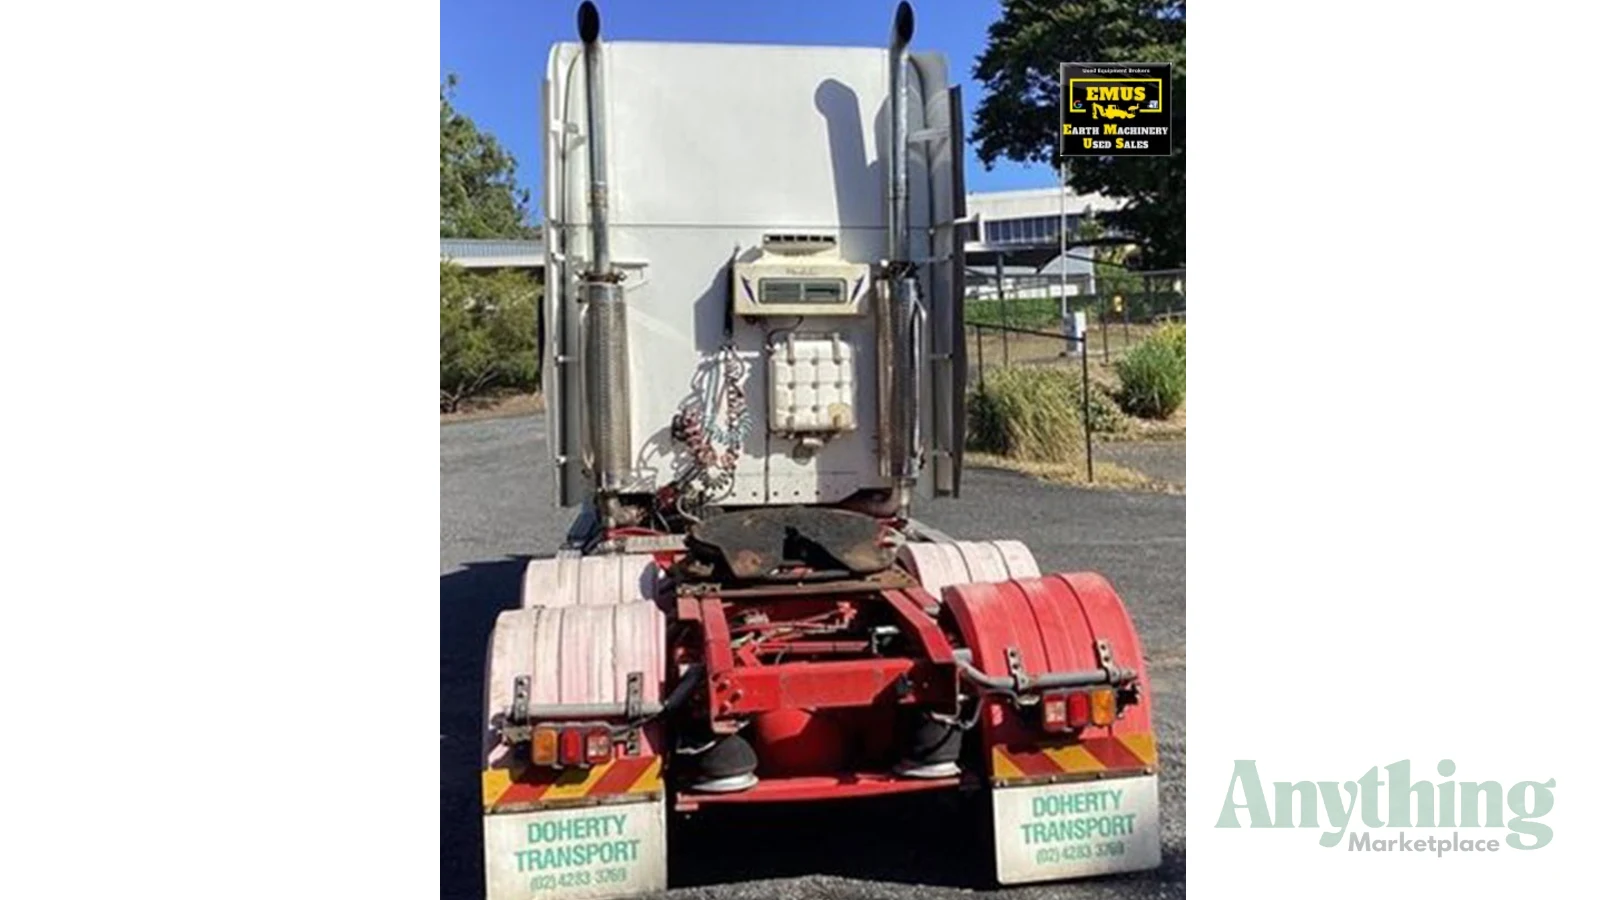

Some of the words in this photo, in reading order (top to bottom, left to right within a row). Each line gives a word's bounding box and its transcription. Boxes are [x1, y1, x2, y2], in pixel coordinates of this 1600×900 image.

[1032, 789, 1122, 817] DOHERTY
[527, 814, 627, 844] DOHERTY
[1020, 814, 1136, 845] TRANSPORT
[514, 839, 640, 872] TRANSPORT
